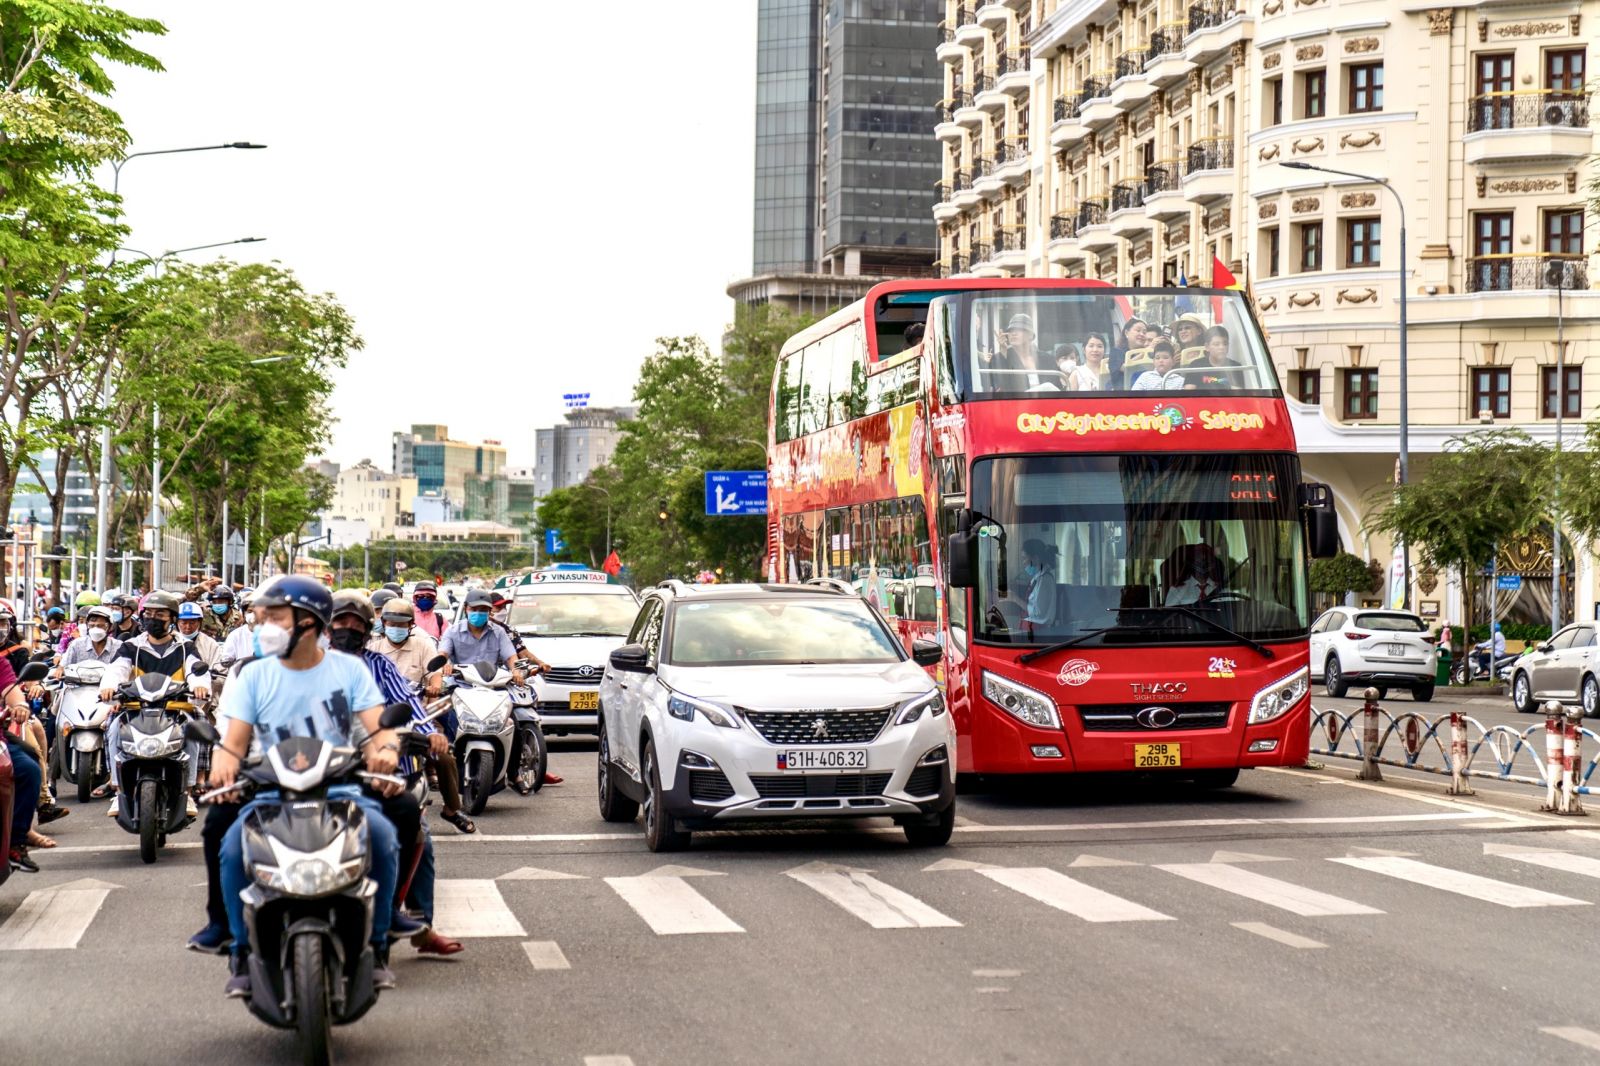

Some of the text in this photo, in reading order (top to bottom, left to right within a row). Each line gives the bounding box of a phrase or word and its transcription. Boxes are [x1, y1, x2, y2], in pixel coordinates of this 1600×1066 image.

[1199, 410, 1264, 431] Saigon
[1060, 664, 1098, 682] OFFICIAL
[1130, 682, 1187, 694] THACO
[1147, 744, 1168, 755] 29B
[1140, 755, 1176, 766] 209.76
